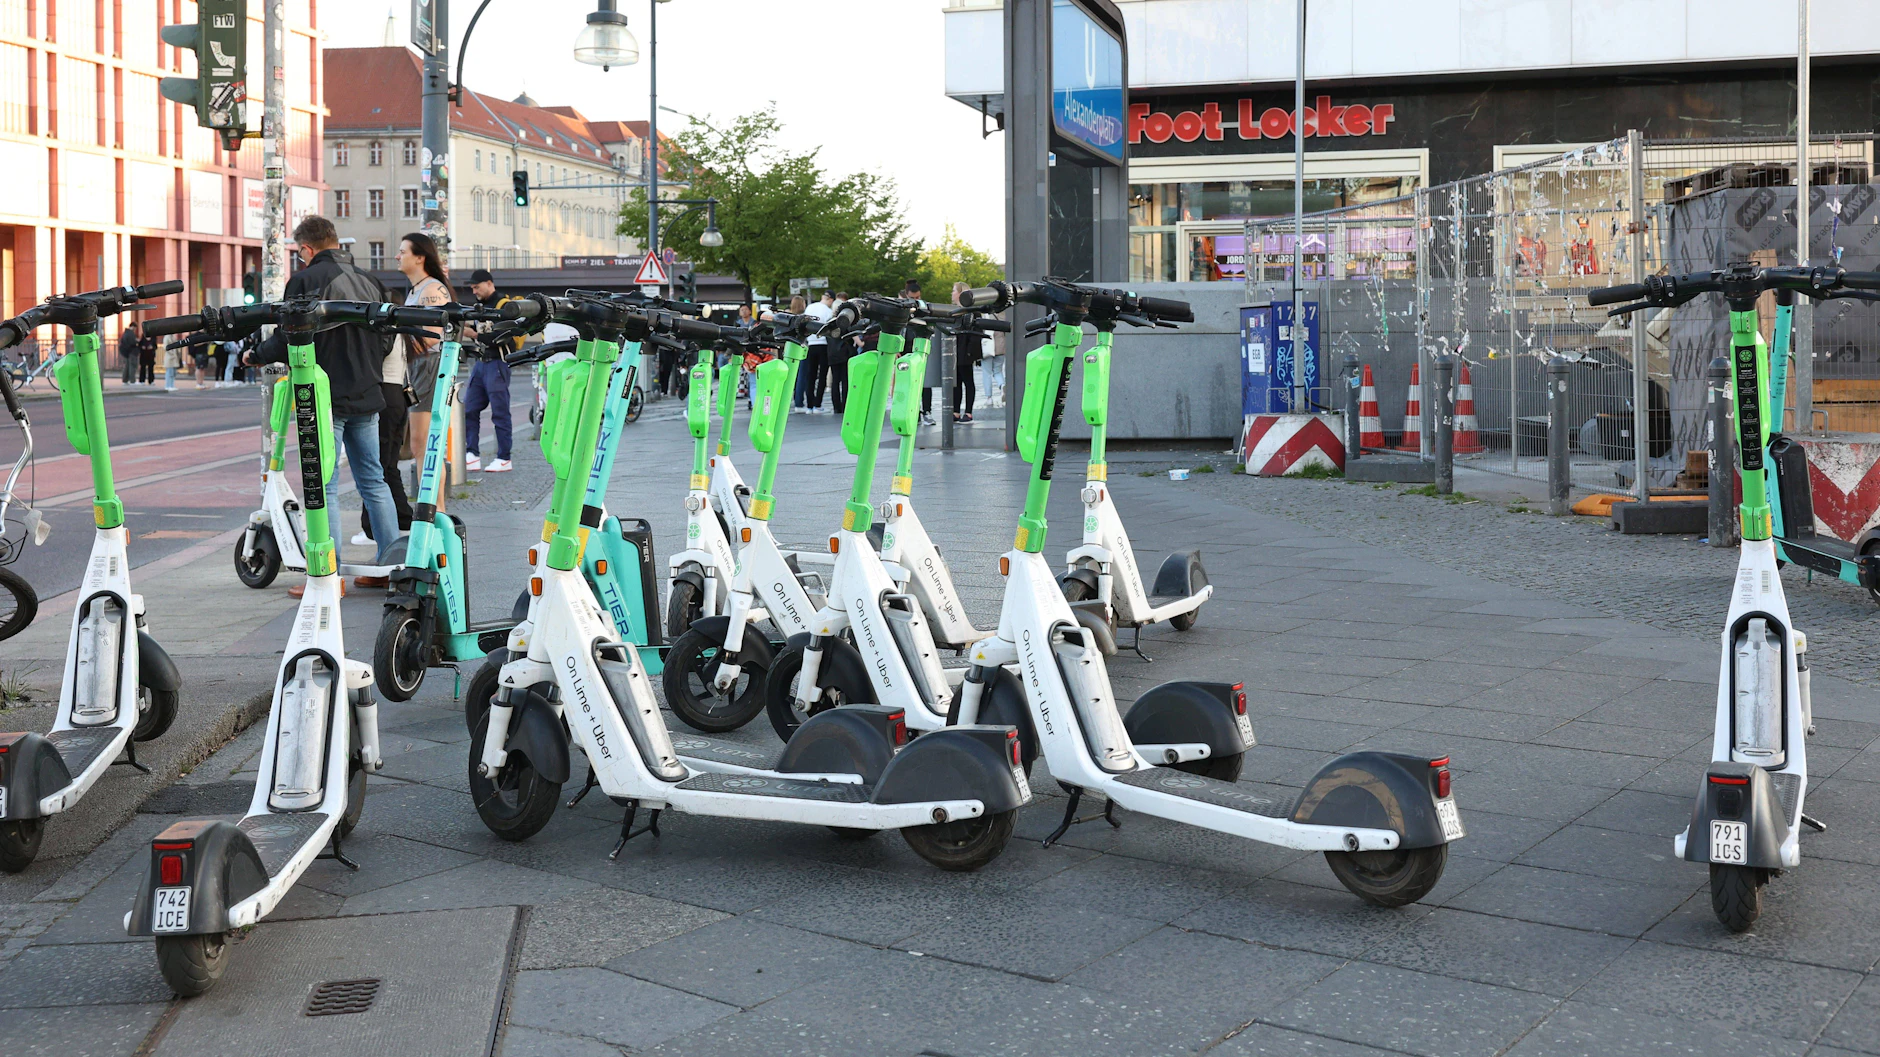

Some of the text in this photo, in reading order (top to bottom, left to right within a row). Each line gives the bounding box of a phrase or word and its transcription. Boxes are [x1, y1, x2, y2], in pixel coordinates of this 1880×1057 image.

[214, 15, 233, 26] FTW
[1084, 21, 1096, 90] U
[1064, 86, 1115, 146] Alexanderplatz
[1128, 95, 1395, 144] Foot Locker
[1742, 191, 1771, 223] RAW
[1843, 189, 1871, 218] RAW
[1860, 232, 1873, 246] 210
[419, 432, 441, 498] TIER
[717, 540, 724, 553] On
[721, 552, 732, 573] Lime
[1116, 536, 1124, 551] On
[1121, 549, 1132, 571] Lime
[1132, 576, 1140, 598] Uber
[445, 575, 459, 627] TIER
[773, 582, 786, 600] On
[782, 597, 802, 624] Lime
[924, 557, 934, 573] On
[931, 571, 945, 595] Lime
[944, 600, 957, 624] Uber
[604, 582, 630, 638] TIER
[855, 598, 866, 619] On
[861, 617, 876, 648] Lime
[876, 657, 893, 689] Uber
[1022, 629, 1033, 653] On
[1026, 653, 1039, 688] Lime
[566, 656, 578, 679] On
[573, 678, 591, 714] Lime
[592, 724, 613, 760] Uber
[1039, 700, 1055, 736] Uber
[712, 746, 765, 760] Lime
[1209, 788, 1272, 805] Lime
[1714, 824, 1742, 841] 791
[1715, 843, 1741, 860] ICS
[159, 890, 186, 908] 742
[157, 910, 185, 928] ICE
